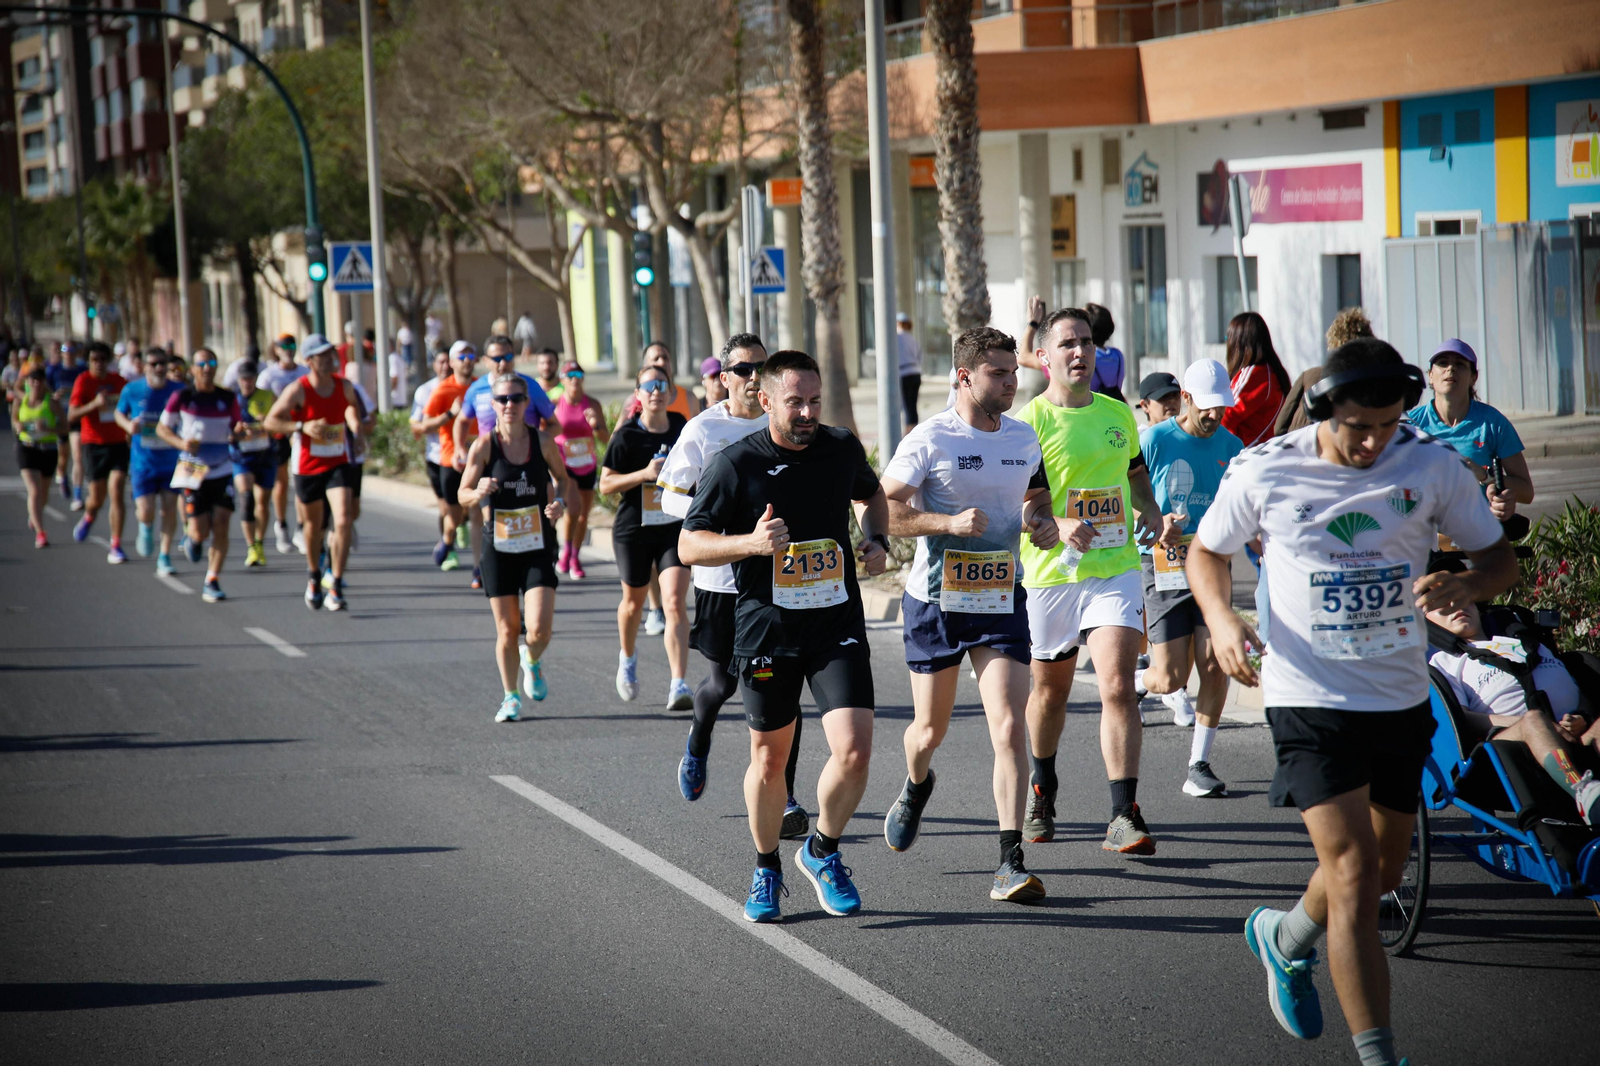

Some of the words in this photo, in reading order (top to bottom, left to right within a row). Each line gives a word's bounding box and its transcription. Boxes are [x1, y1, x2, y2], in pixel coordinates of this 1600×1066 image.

[958, 462, 972, 470] 90
[1172, 494, 1186, 502] 40
[1074, 498, 1120, 517] 1040
[504, 515, 533, 530] 212
[1166, 545, 1187, 561] 83
[1329, 550, 1382, 560] Fundación
[781, 549, 838, 575] 2133
[952, 561, 1009, 581] 1865
[1322, 581, 1403, 613] 5392
[1346, 610, 1382, 620] ARTURO
